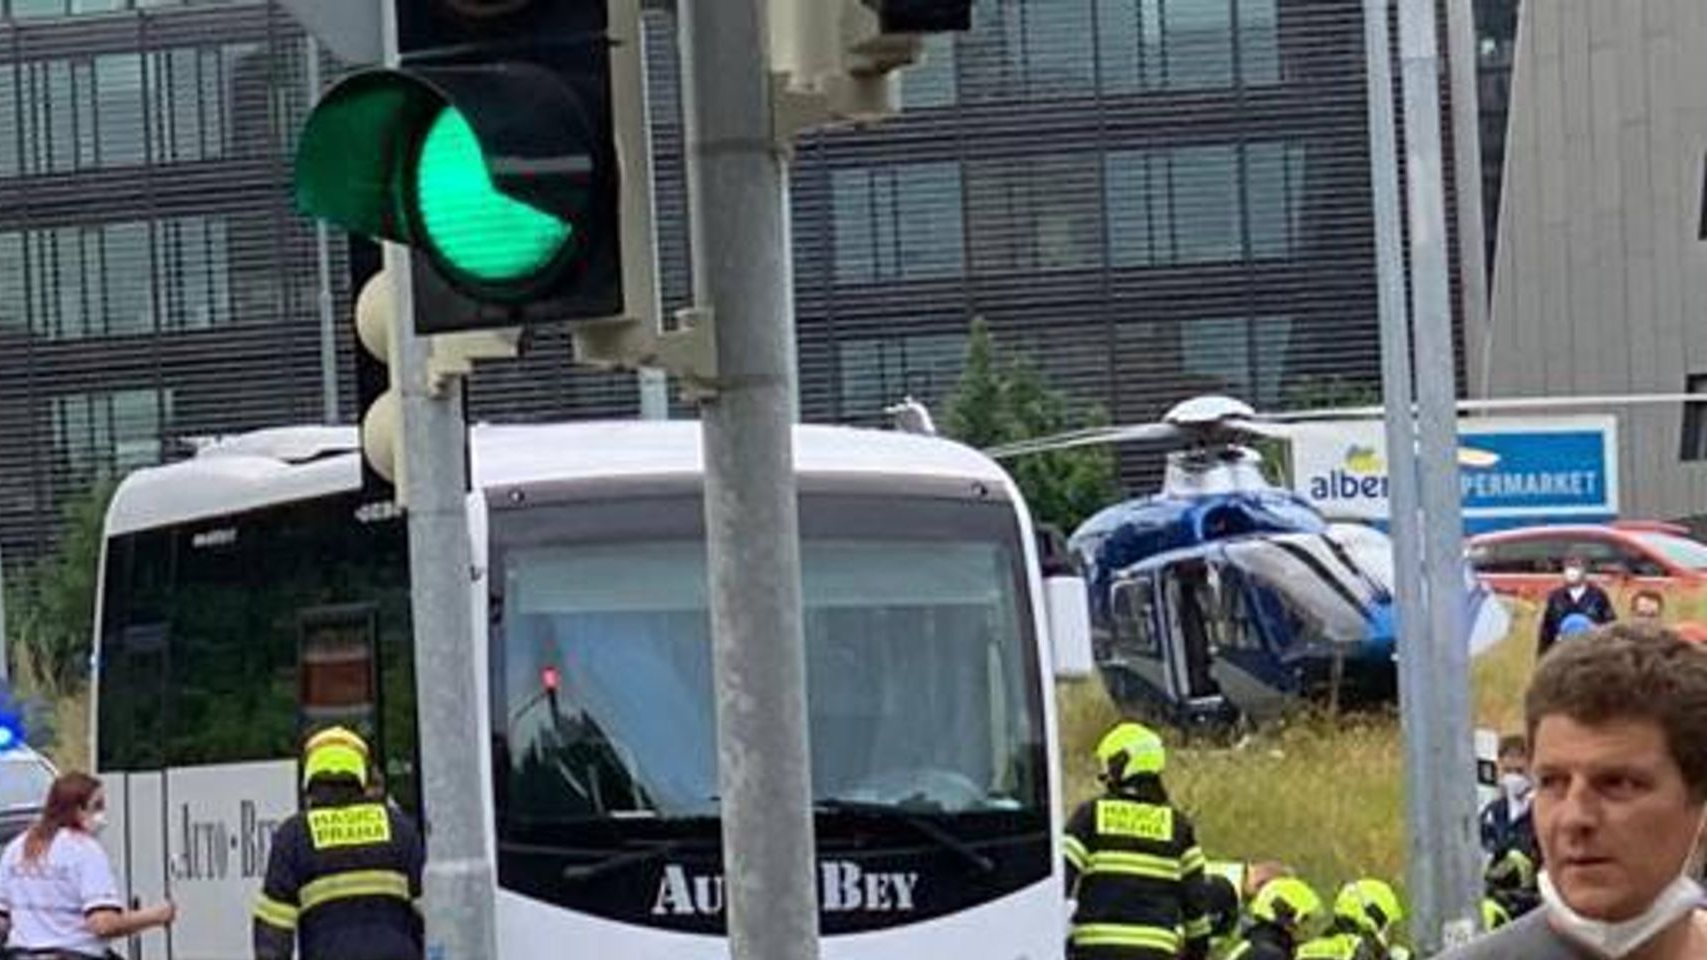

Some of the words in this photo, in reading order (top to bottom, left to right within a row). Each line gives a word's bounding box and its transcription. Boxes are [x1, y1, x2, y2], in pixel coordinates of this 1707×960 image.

[1310, 468, 1389, 499] alber
[1460, 471, 1596, 498] PERMARKET
[820, 860, 920, 911] BEY
